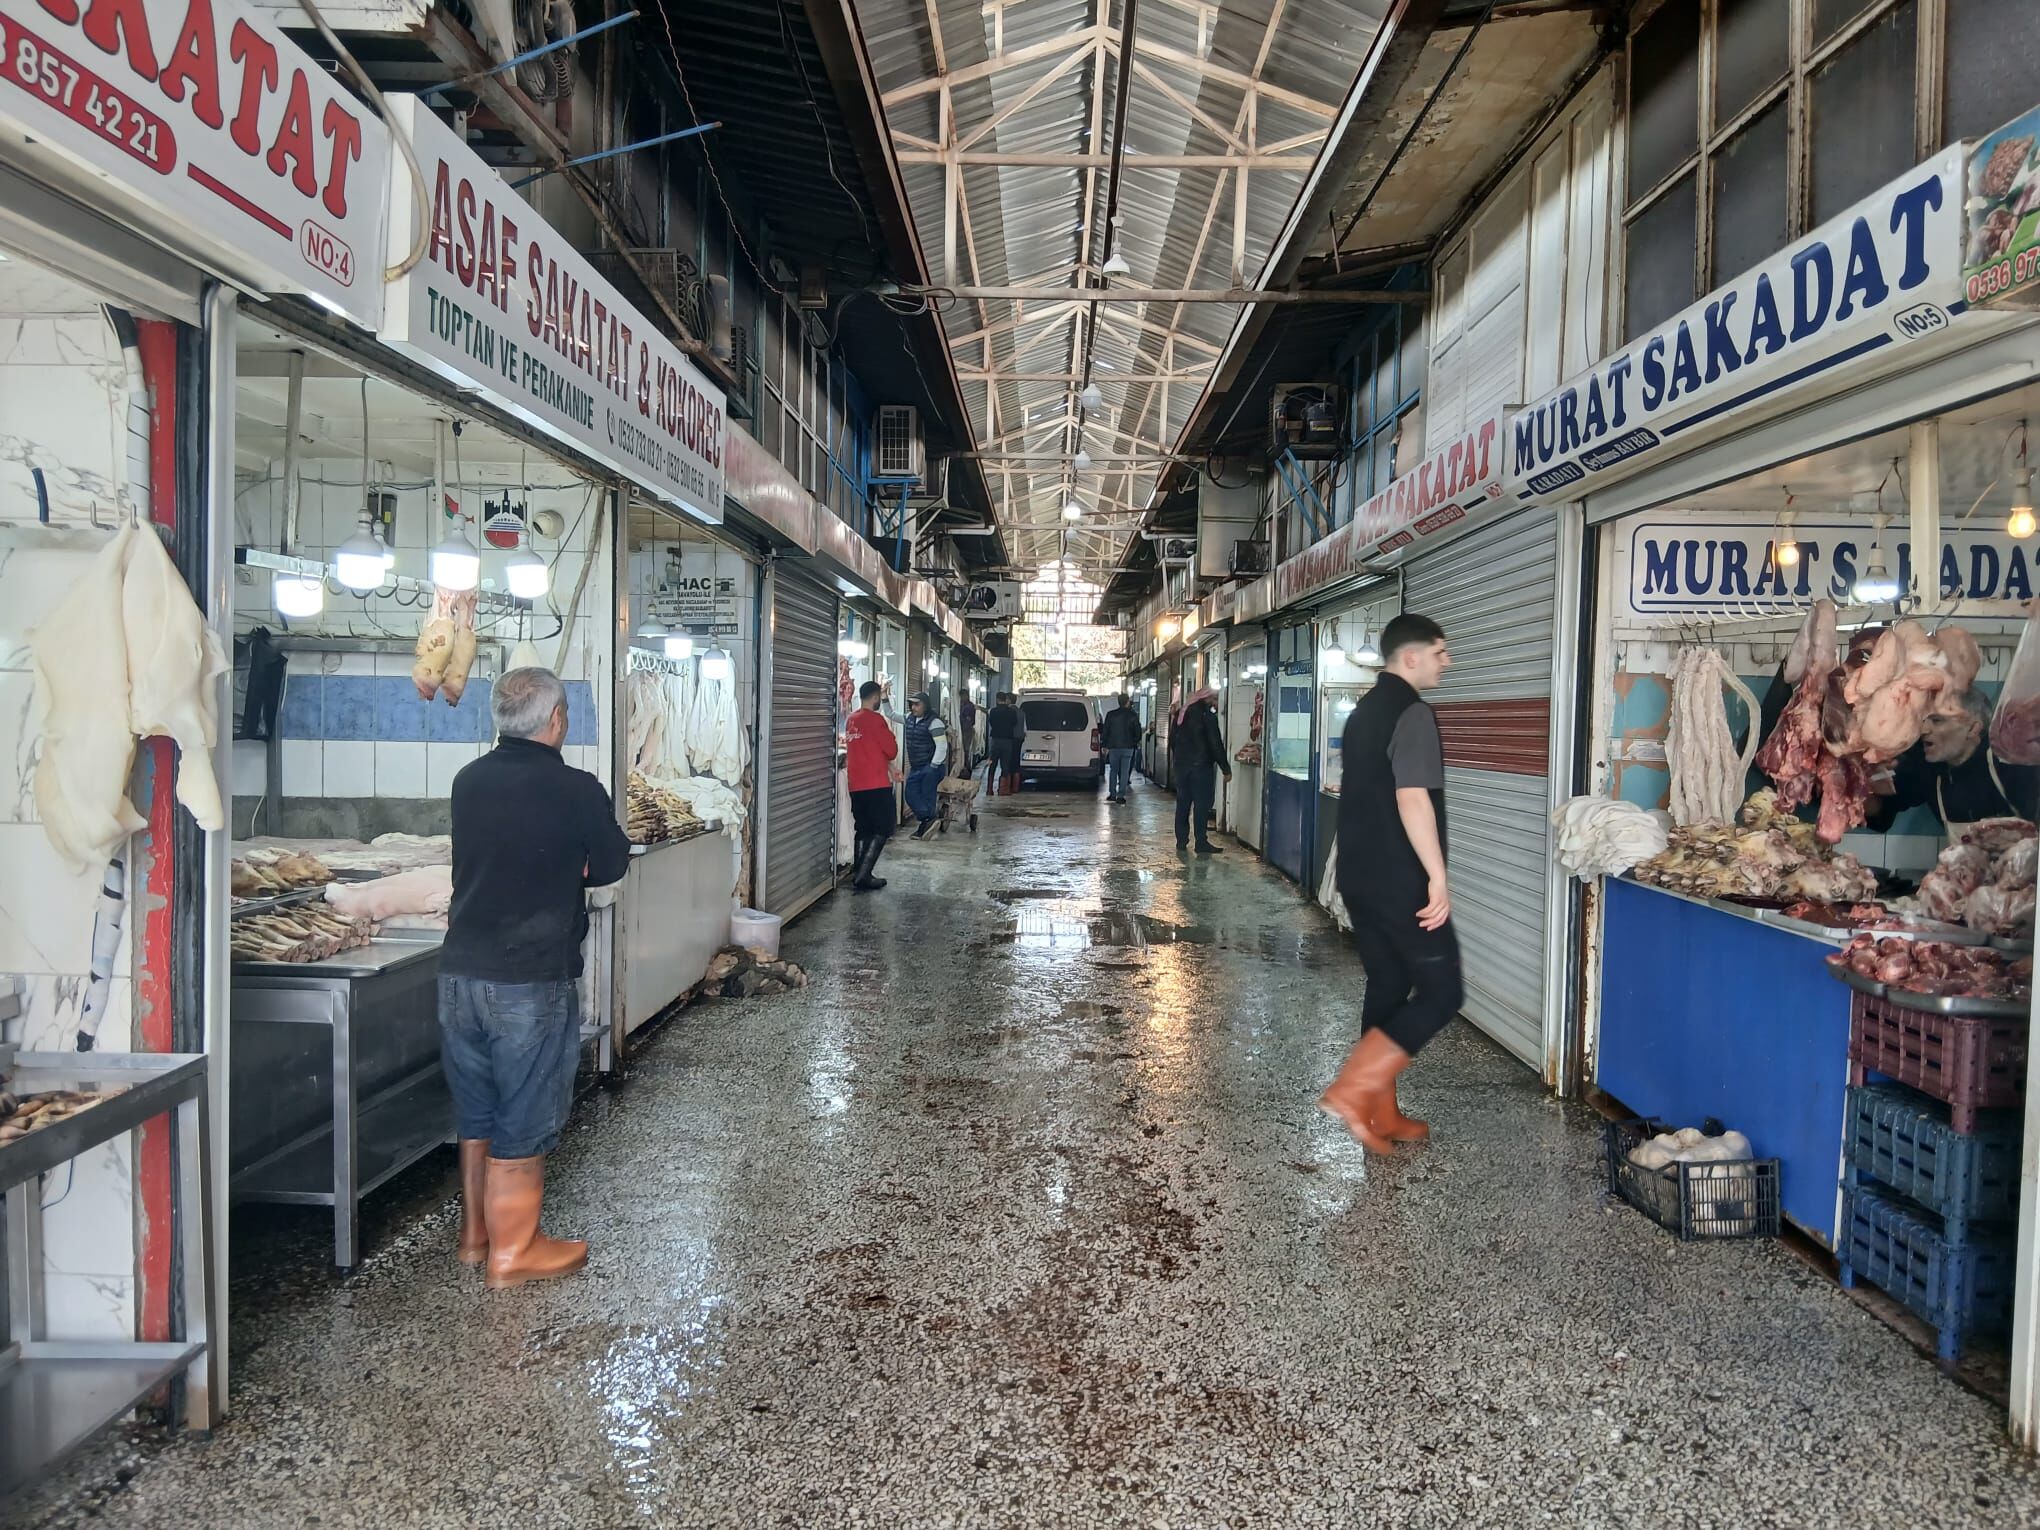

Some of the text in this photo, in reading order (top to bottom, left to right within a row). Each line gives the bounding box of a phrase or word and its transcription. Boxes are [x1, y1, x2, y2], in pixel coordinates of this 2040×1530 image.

[16, 38, 80, 108] 857
[85, 83, 124, 140] 42
[129, 111, 159, 162] 21
[307, 227, 350, 280] NO:4
[1967, 246, 2040, 303] 0536 97
[429, 158, 518, 314] ASAF
[527, 241, 632, 401] SAKATAT
[637, 341, 651, 419] &
[1513, 174, 1943, 477] MURAT SAKADAT
[1899, 306, 1943, 339] NO:5
[428, 287, 595, 431] TOPTAN VE PERAKANDE
[618, 417, 635, 456] 0533
[1394, 417, 1496, 521] SAKATAT
[677, 577, 711, 591] HAC
[1831, 540, 2040, 600] SADA
